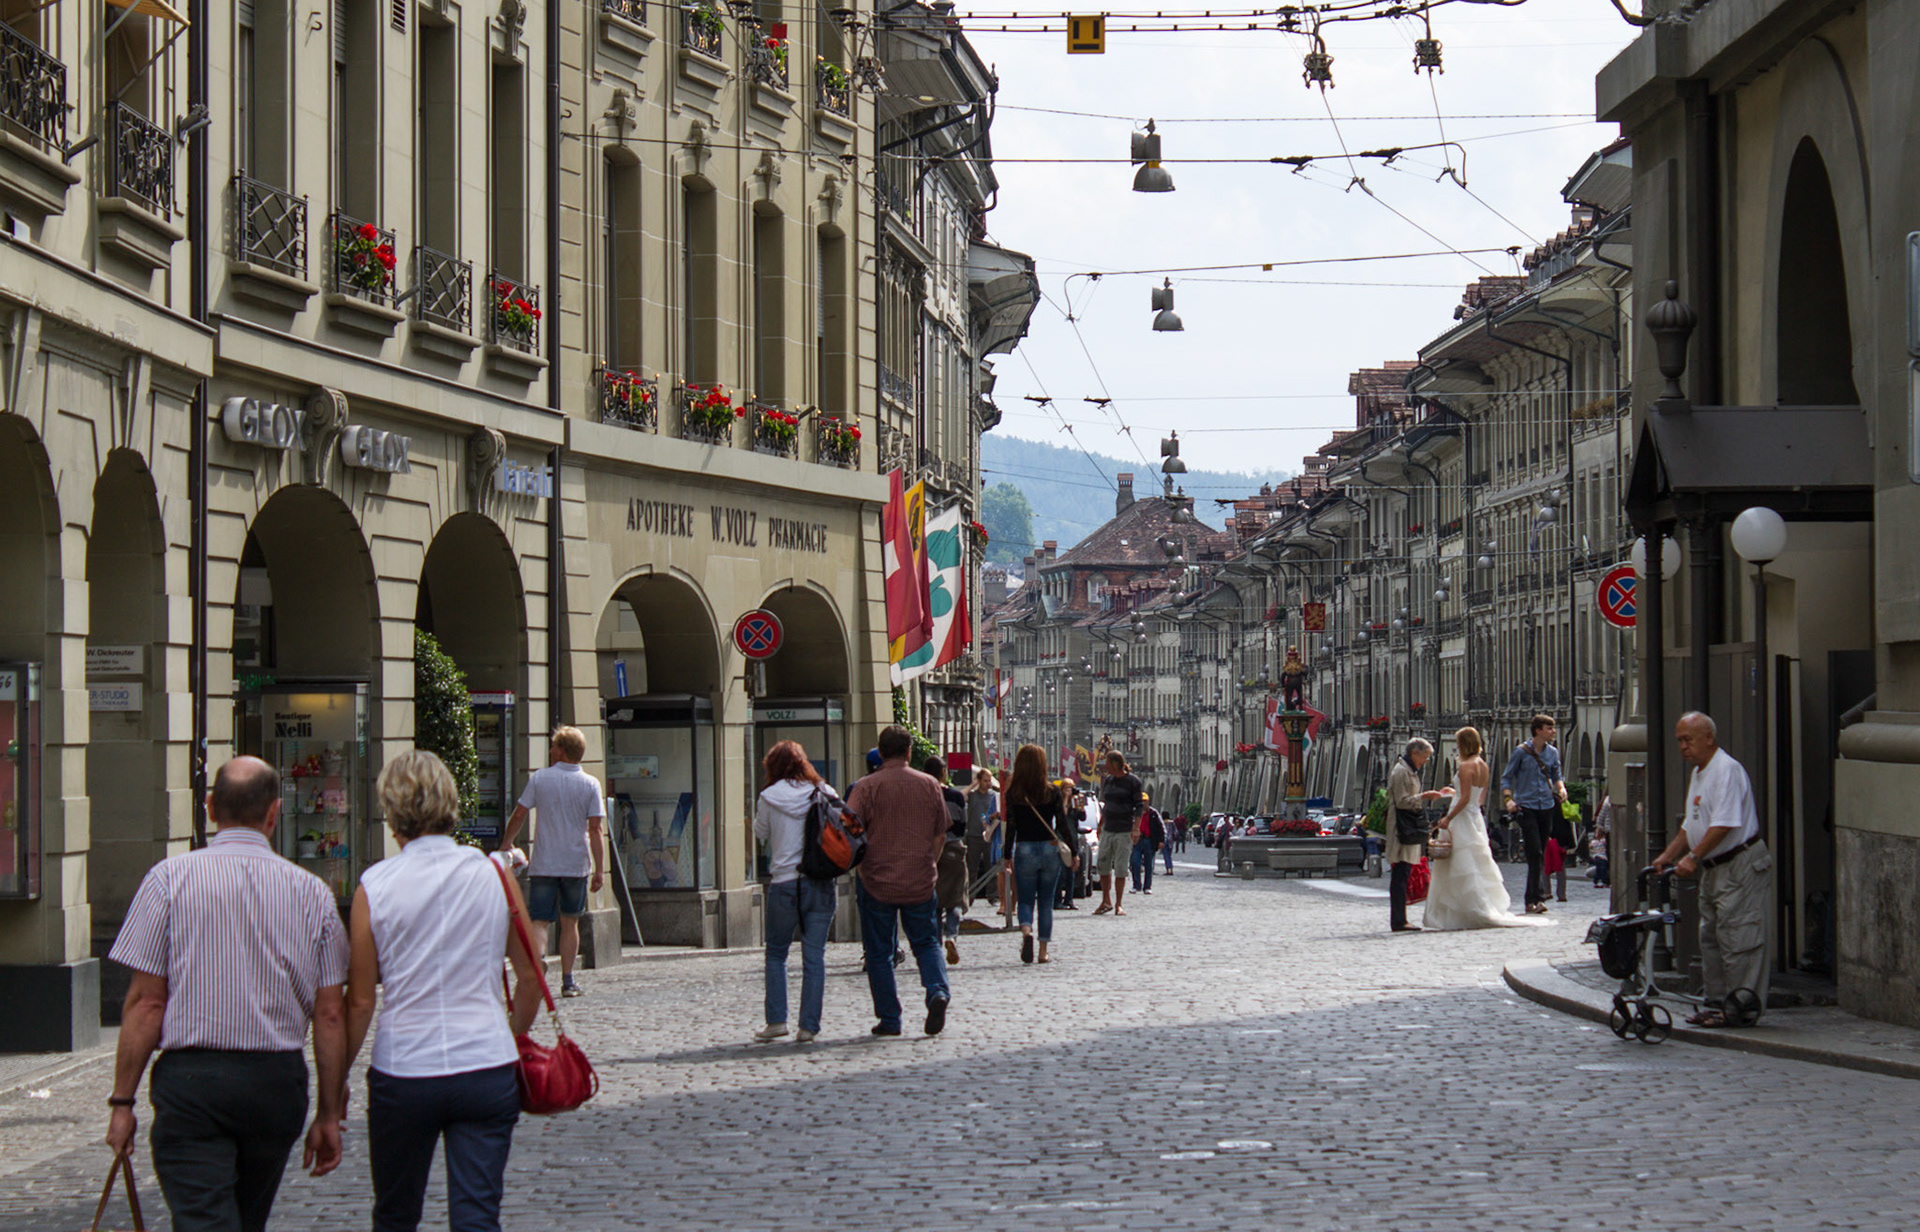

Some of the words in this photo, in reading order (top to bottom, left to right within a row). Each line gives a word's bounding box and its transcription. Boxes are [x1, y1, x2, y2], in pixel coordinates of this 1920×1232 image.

[227, 397, 306, 450] GEOX
[342, 425, 412, 474] GEOX
[626, 497, 694, 538] APOTHEKE
[769, 517, 827, 553] PHARMACIE
[275, 712, 312, 721] Boutique
[275, 722, 312, 737] Nelli
[766, 711, 791, 719] VOLZ
